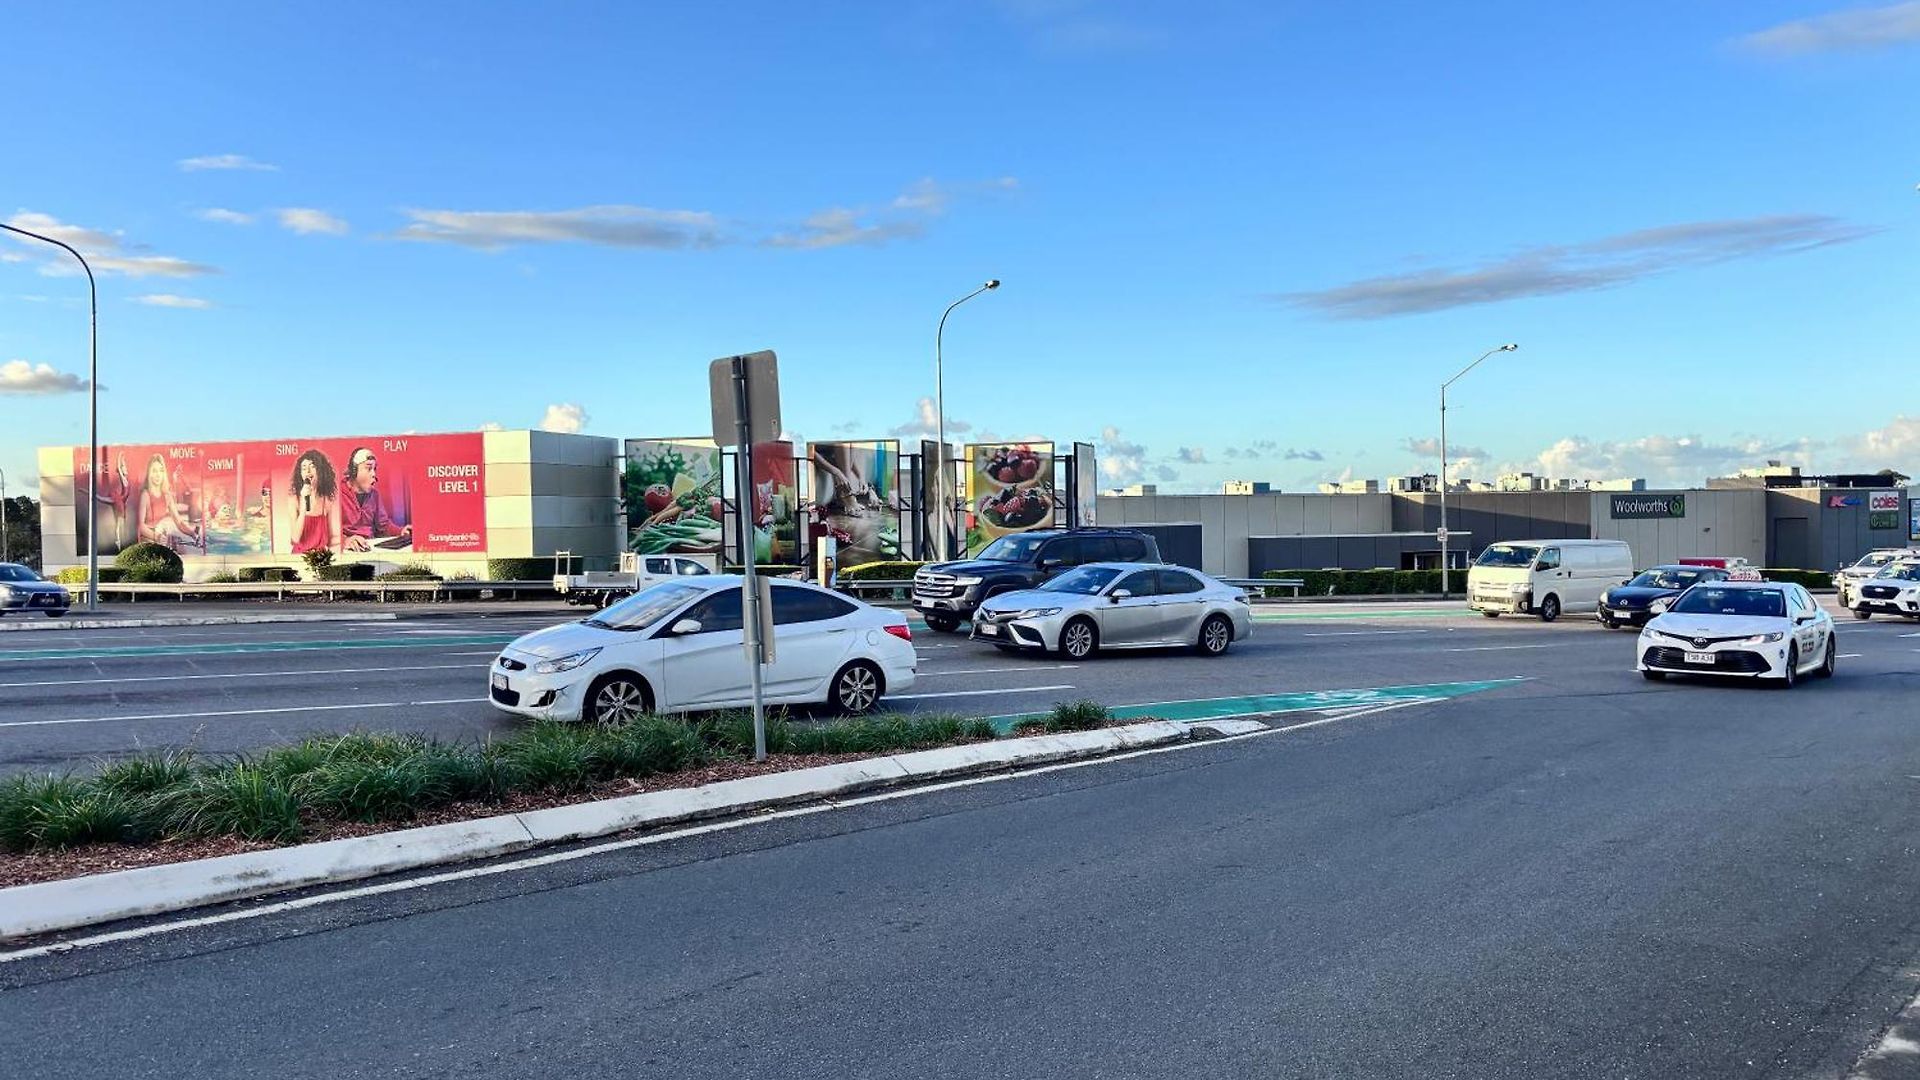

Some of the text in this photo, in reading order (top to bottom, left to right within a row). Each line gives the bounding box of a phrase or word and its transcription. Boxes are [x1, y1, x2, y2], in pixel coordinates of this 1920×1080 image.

[276, 444, 298, 456] SING
[384, 440, 408, 452] PLAY
[170, 447, 195, 459] MOVE
[80, 463, 109, 474] DACE
[207, 459, 234, 471] SWIM
[428, 465, 479, 478] DISCOVER
[439, 480, 478, 493] LEVEL 1
[1614, 499, 1668, 513] Woolworths
